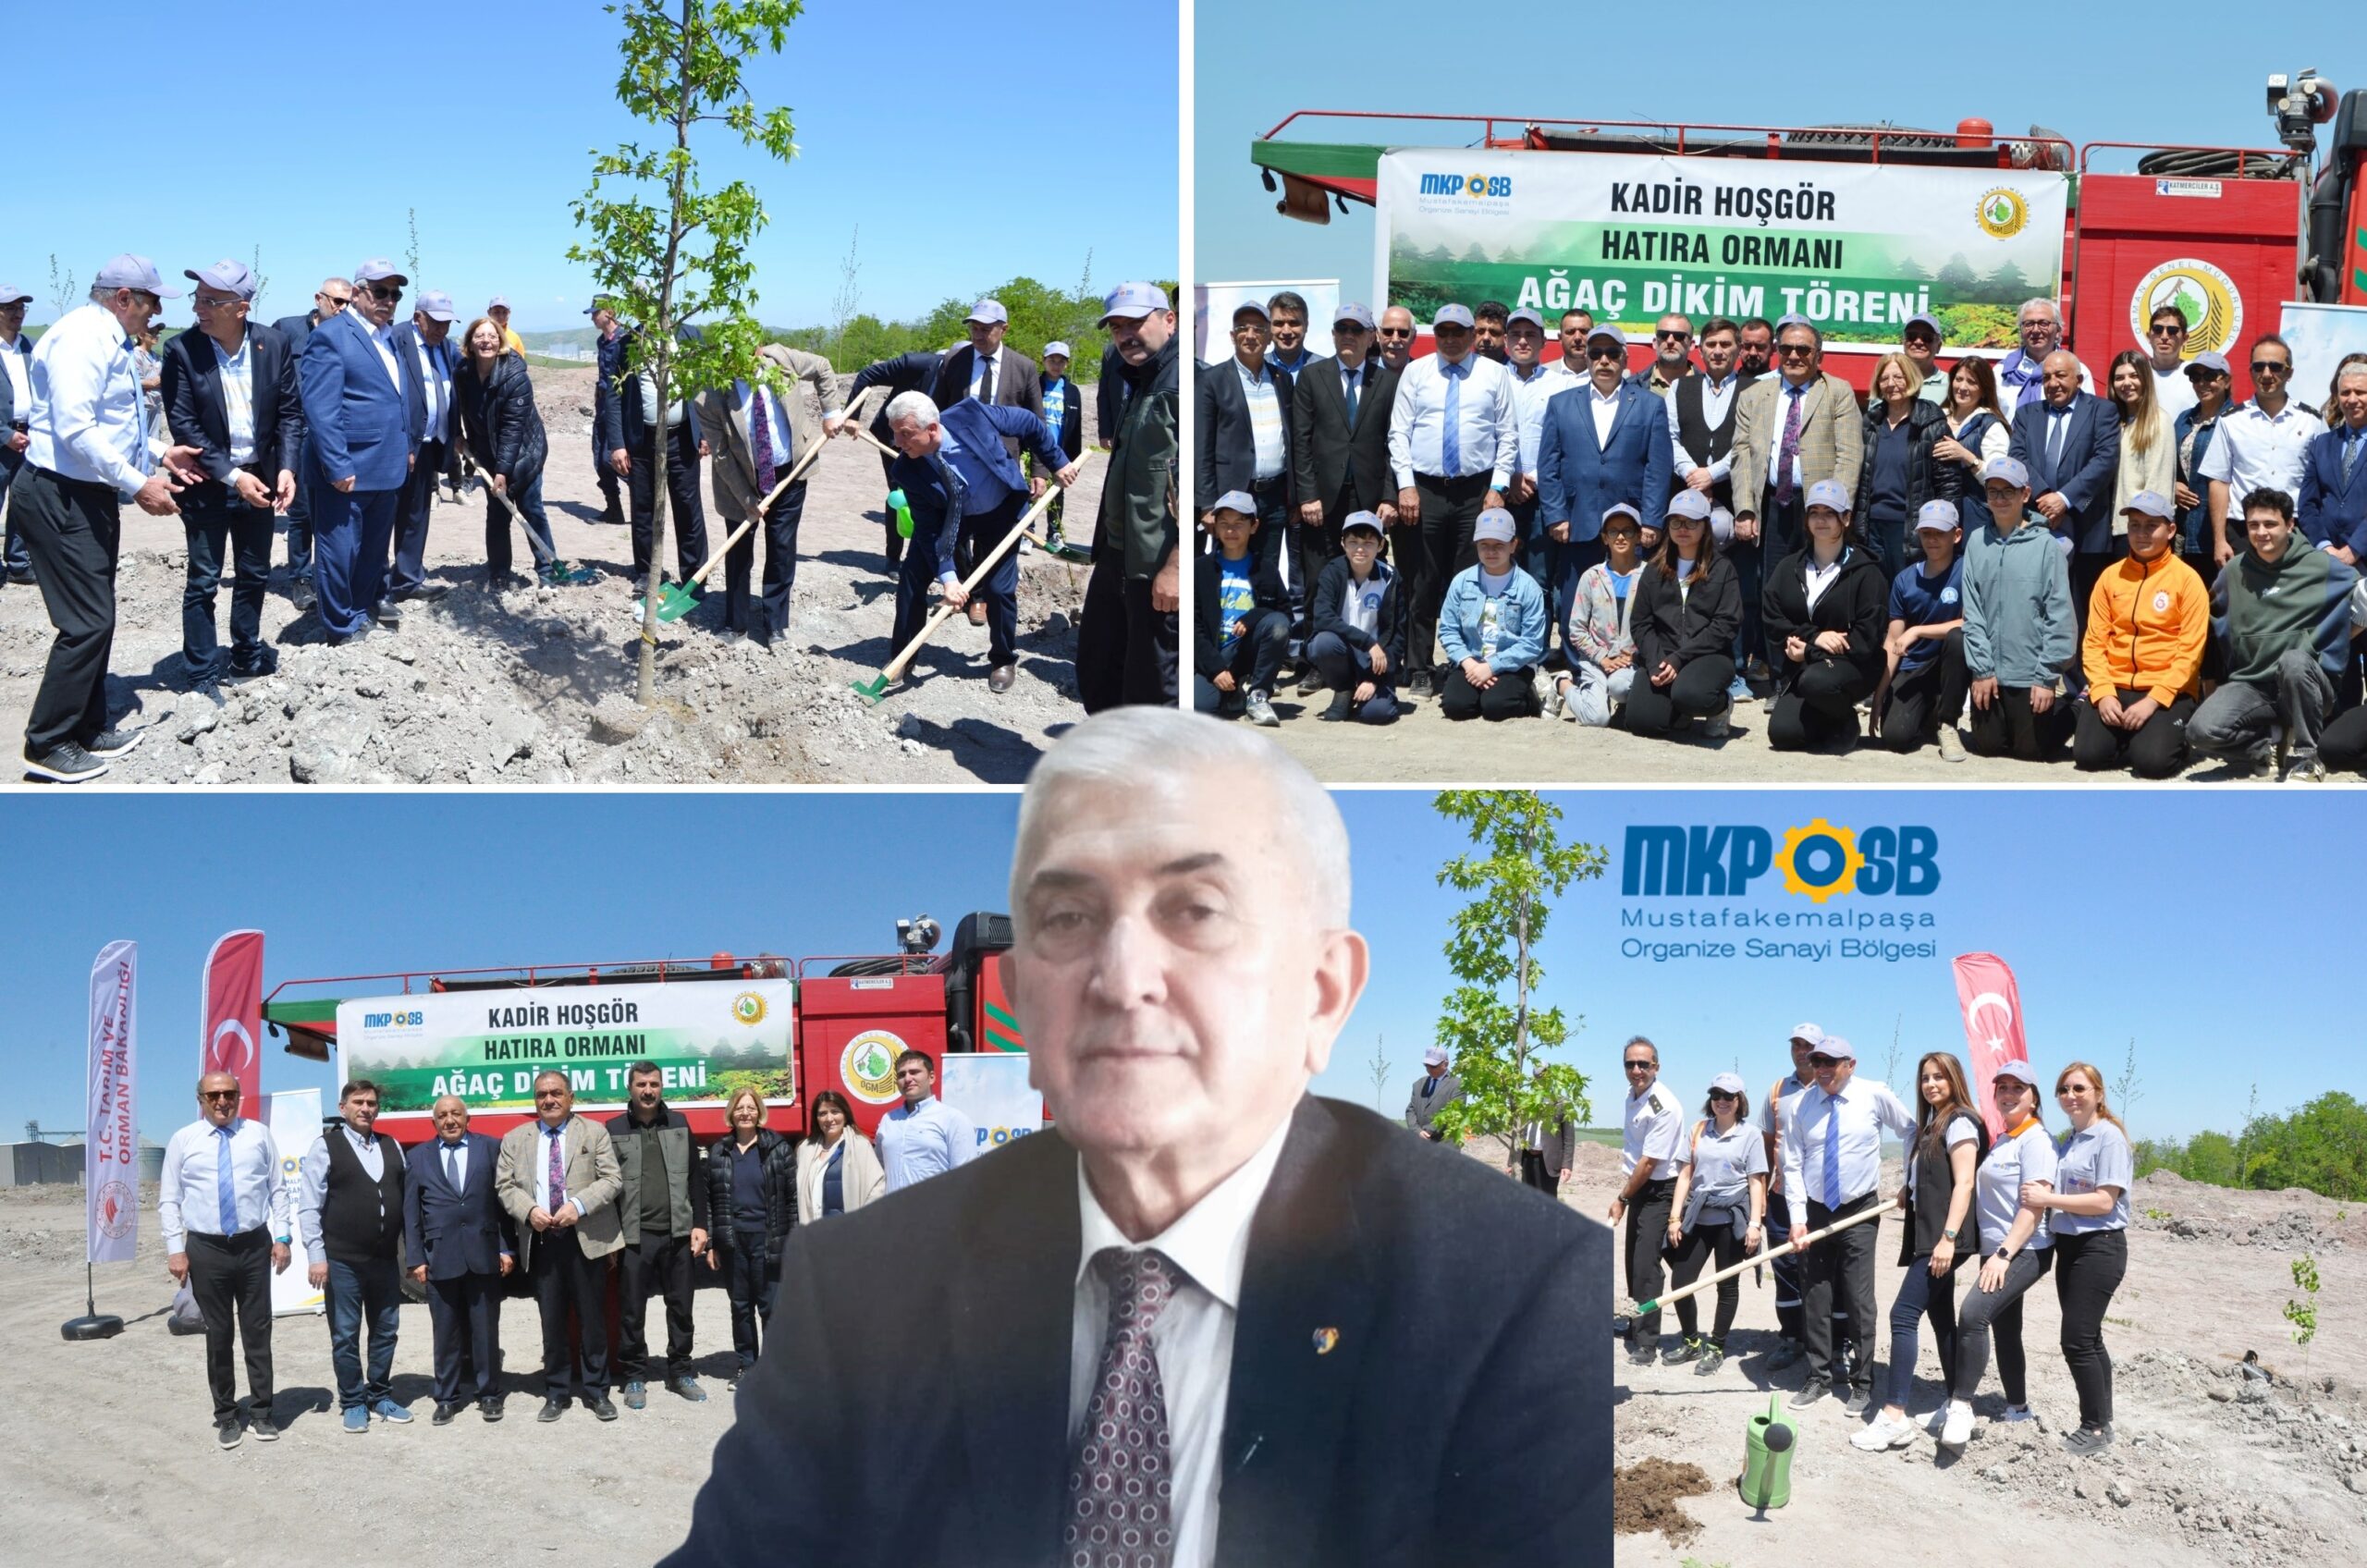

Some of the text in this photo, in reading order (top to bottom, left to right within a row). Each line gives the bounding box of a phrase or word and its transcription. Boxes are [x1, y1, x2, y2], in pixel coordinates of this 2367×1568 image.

[1611, 177, 1835, 227] KADİR HOŞGÖR
[1601, 229, 1843, 269] HATIRA ORMANI
[1516, 268, 1930, 324] AĞAÇ DİKİM TÖRENİ
[103, 1015, 115, 1042] VE
[488, 998, 639, 1030] KADİR HOŞGÖR
[484, 1034, 645, 1060] HATIRA ORMANI
[100, 1049, 114, 1117] TARIM
[431, 1068, 504, 1100] AĞAÇ
[861, 1080, 879, 1094] OGM
[117, 1083, 131, 1165] ORMAN
